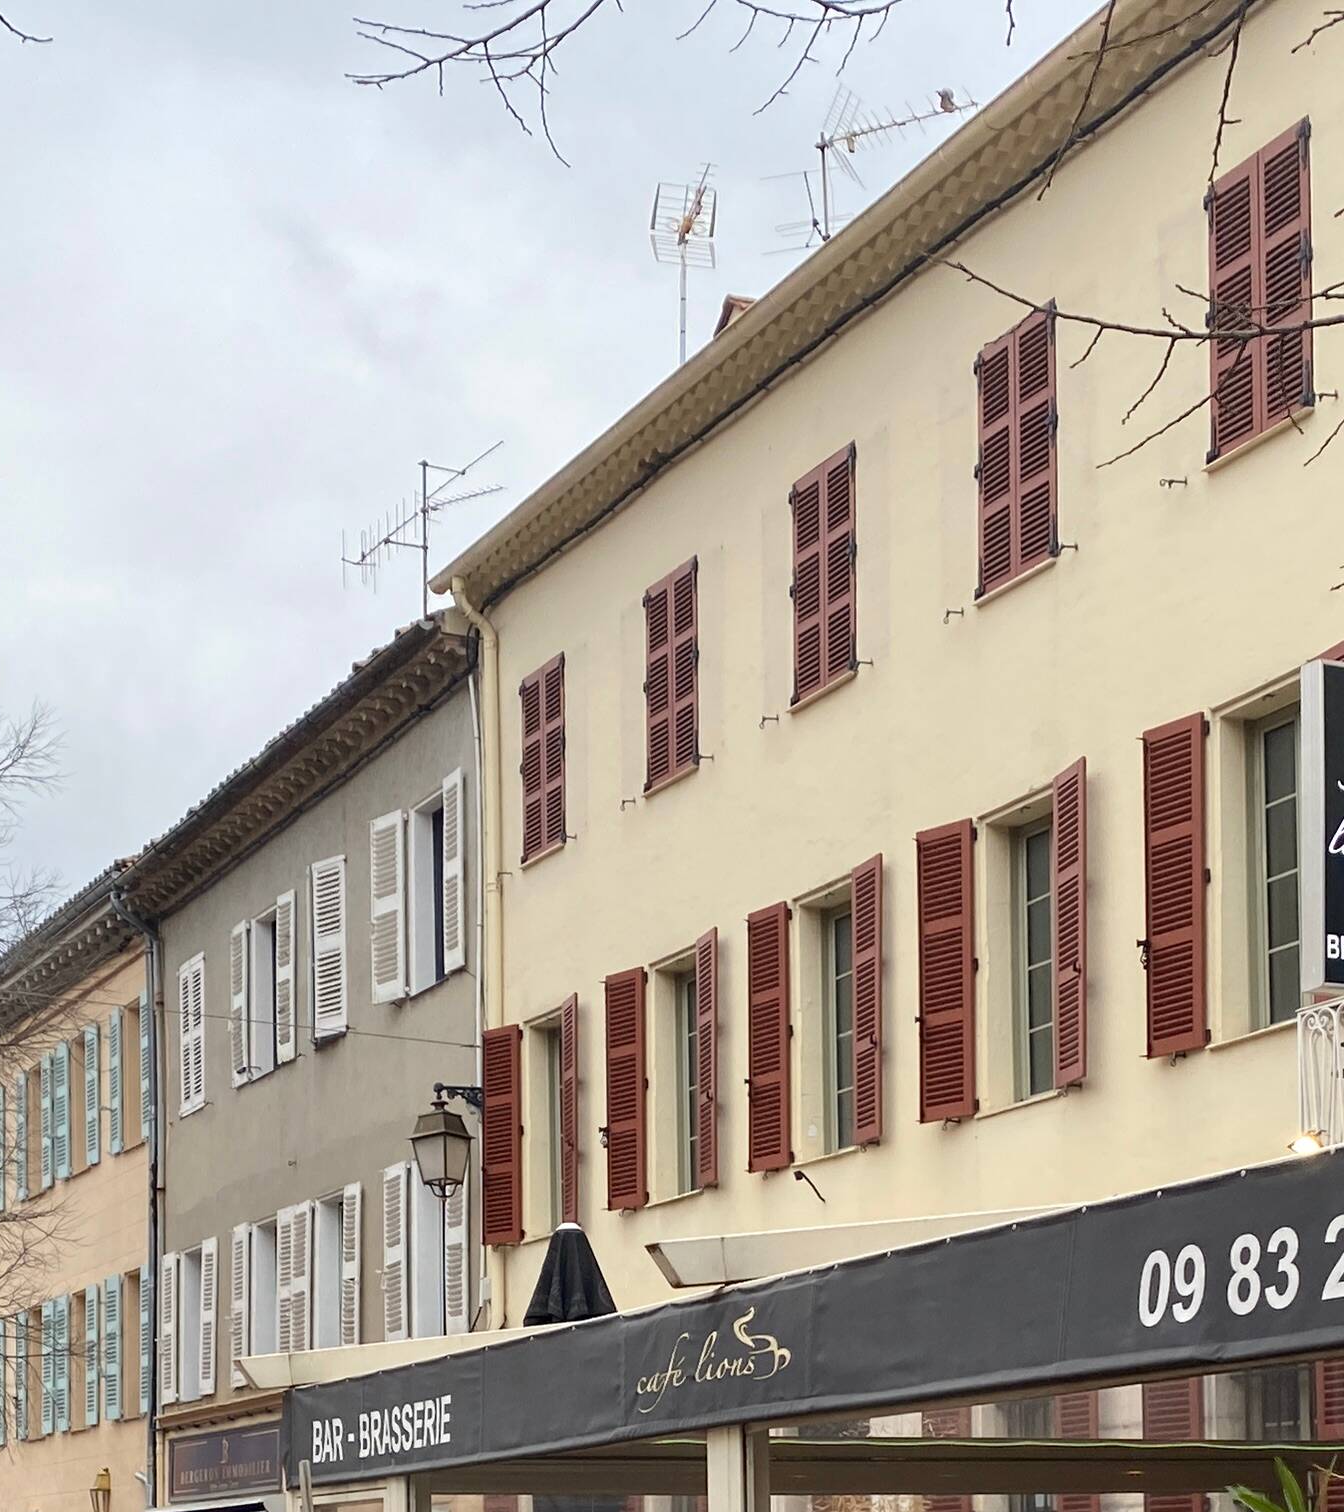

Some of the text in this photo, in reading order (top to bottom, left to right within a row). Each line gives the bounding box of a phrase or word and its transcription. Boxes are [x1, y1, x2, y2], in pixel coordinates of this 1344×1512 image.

[1138, 1244, 1206, 1328] 09
[1226, 1227, 1300, 1316] 83
[637, 1331, 755, 1413] café lions
[312, 1417, 344, 1464] BAR
[358, 1394, 452, 1460] BRASSERIE
[222, 1459, 271, 1480] IMMOBILIER
